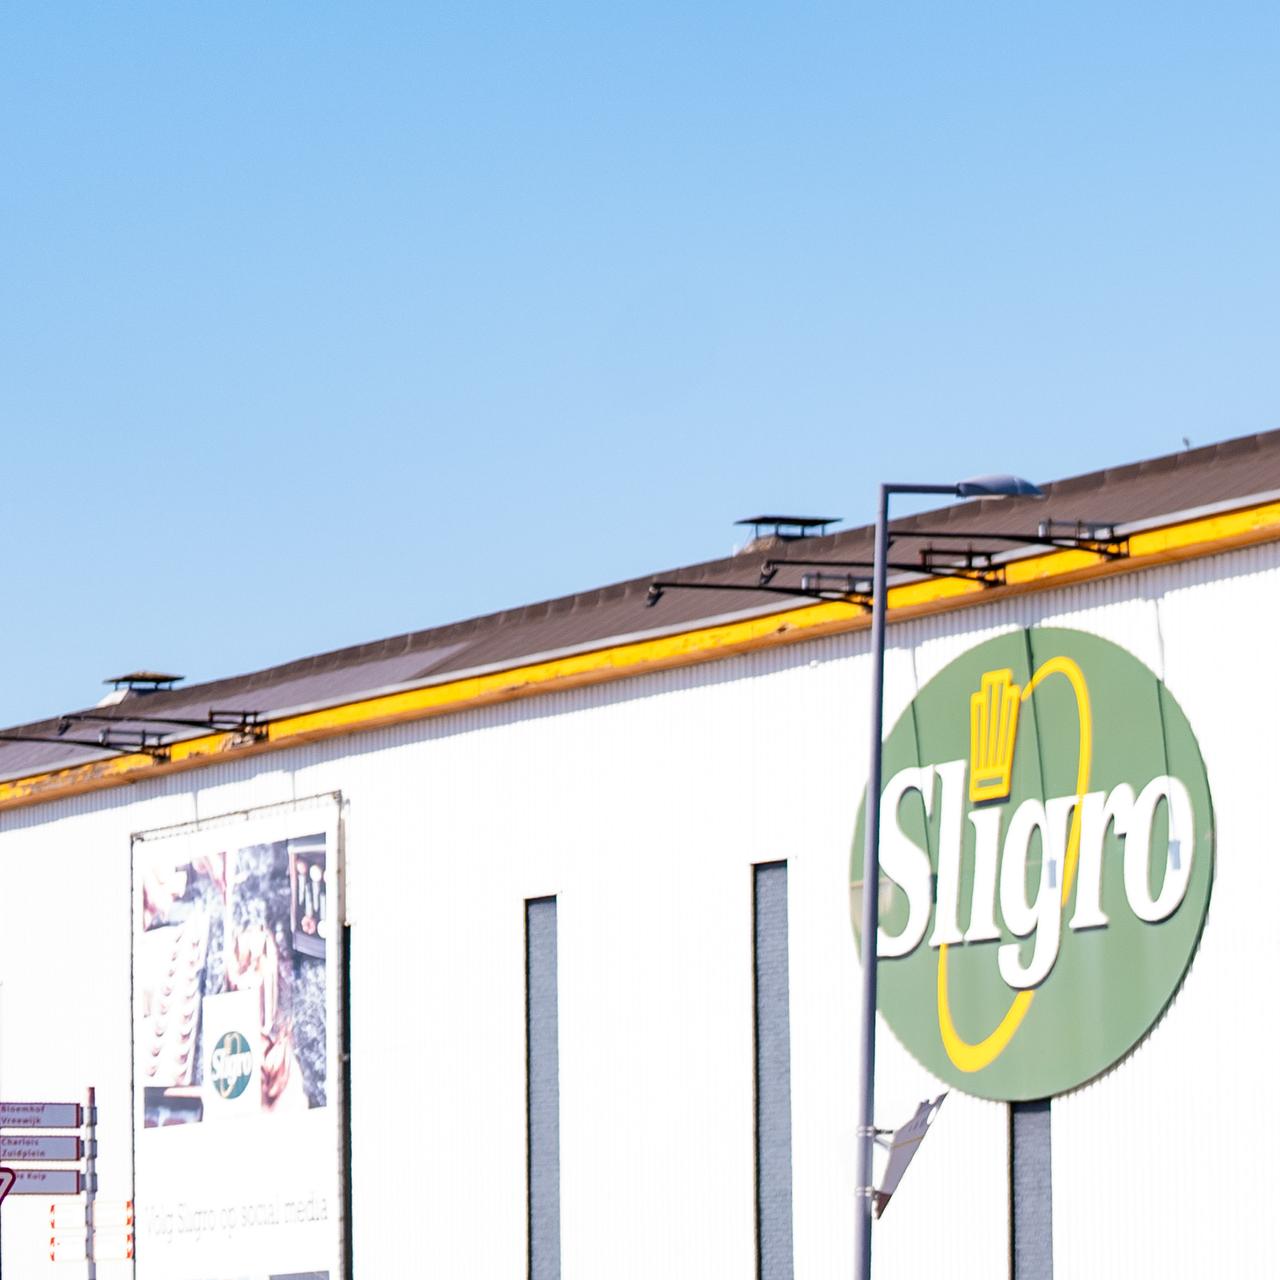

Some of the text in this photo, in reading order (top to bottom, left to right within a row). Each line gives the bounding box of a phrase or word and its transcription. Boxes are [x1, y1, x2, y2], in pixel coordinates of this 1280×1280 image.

[877, 758, 1195, 990] Sligro
[211, 1047, 252, 1084] Sligro
[2, 1149, 45, 1159] Zuidplein
